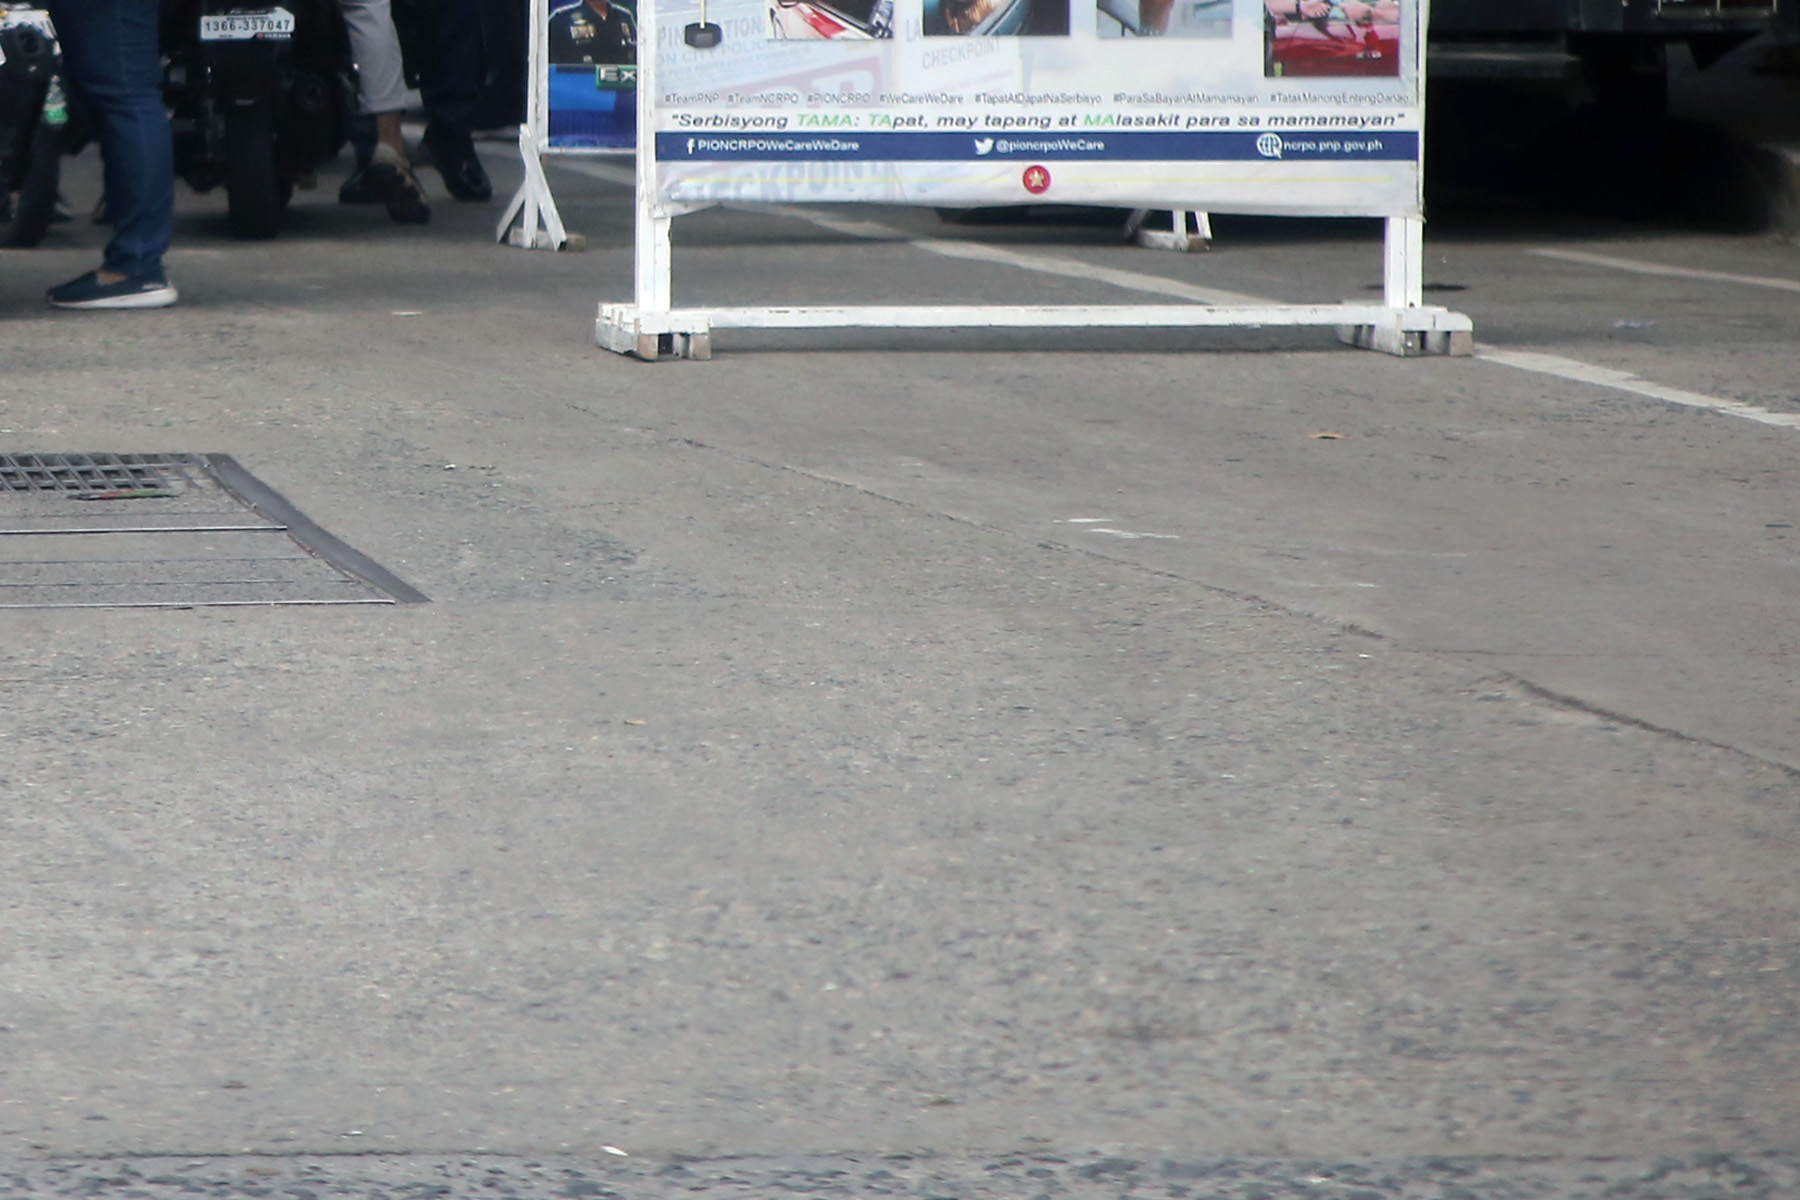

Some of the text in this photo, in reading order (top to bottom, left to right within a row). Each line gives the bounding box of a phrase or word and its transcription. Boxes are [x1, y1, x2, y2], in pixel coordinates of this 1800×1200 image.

[206, 20, 290, 31] 1366-337047
[665, 93, 719, 103] #TeamPNP
[728, 93, 798, 103] #TeamNCRPO
[880, 93, 963, 103] #WeCareWeDare
[798, 114, 859, 127] TAMA:
[869, 114, 928, 128] TApat,
[937, 116, 978, 129] may
[985, 114, 1052, 129] tapang
[1059, 114, 1078, 126] at
[1084, 113, 1180, 126] MAlasakit
[1186, 116, 1230, 129] para
[1238, 116, 1260, 126] sa
[996, 139, 1104, 153] @pioncrpoWeCare
[1283, 138, 1383, 153] ncrpo.pnp.gov.ph
